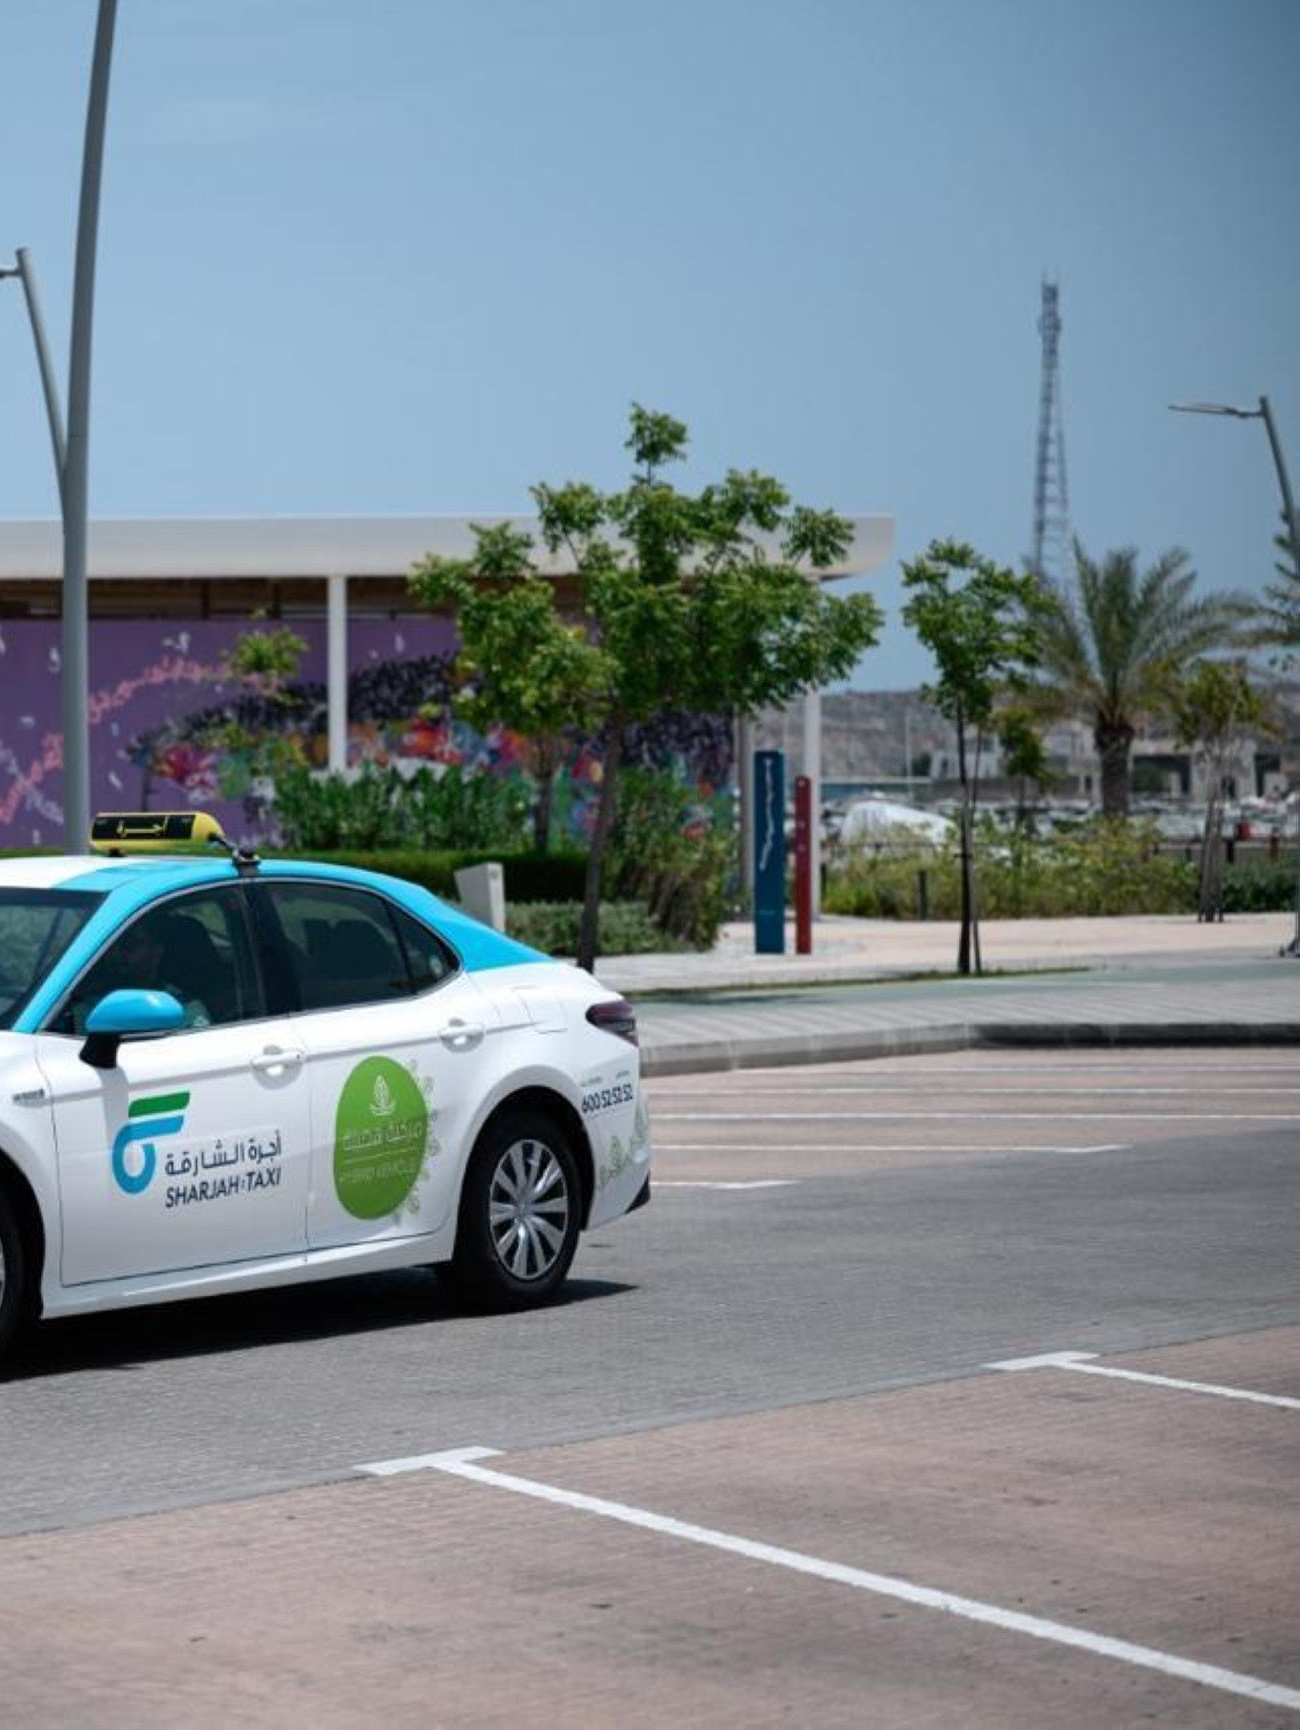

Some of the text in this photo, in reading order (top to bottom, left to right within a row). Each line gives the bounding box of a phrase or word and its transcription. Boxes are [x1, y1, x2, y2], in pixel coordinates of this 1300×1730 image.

[164, 1128, 282, 1177] أجرة الشارقة
[164, 1167, 282, 1208] SHARJAH TAXI
